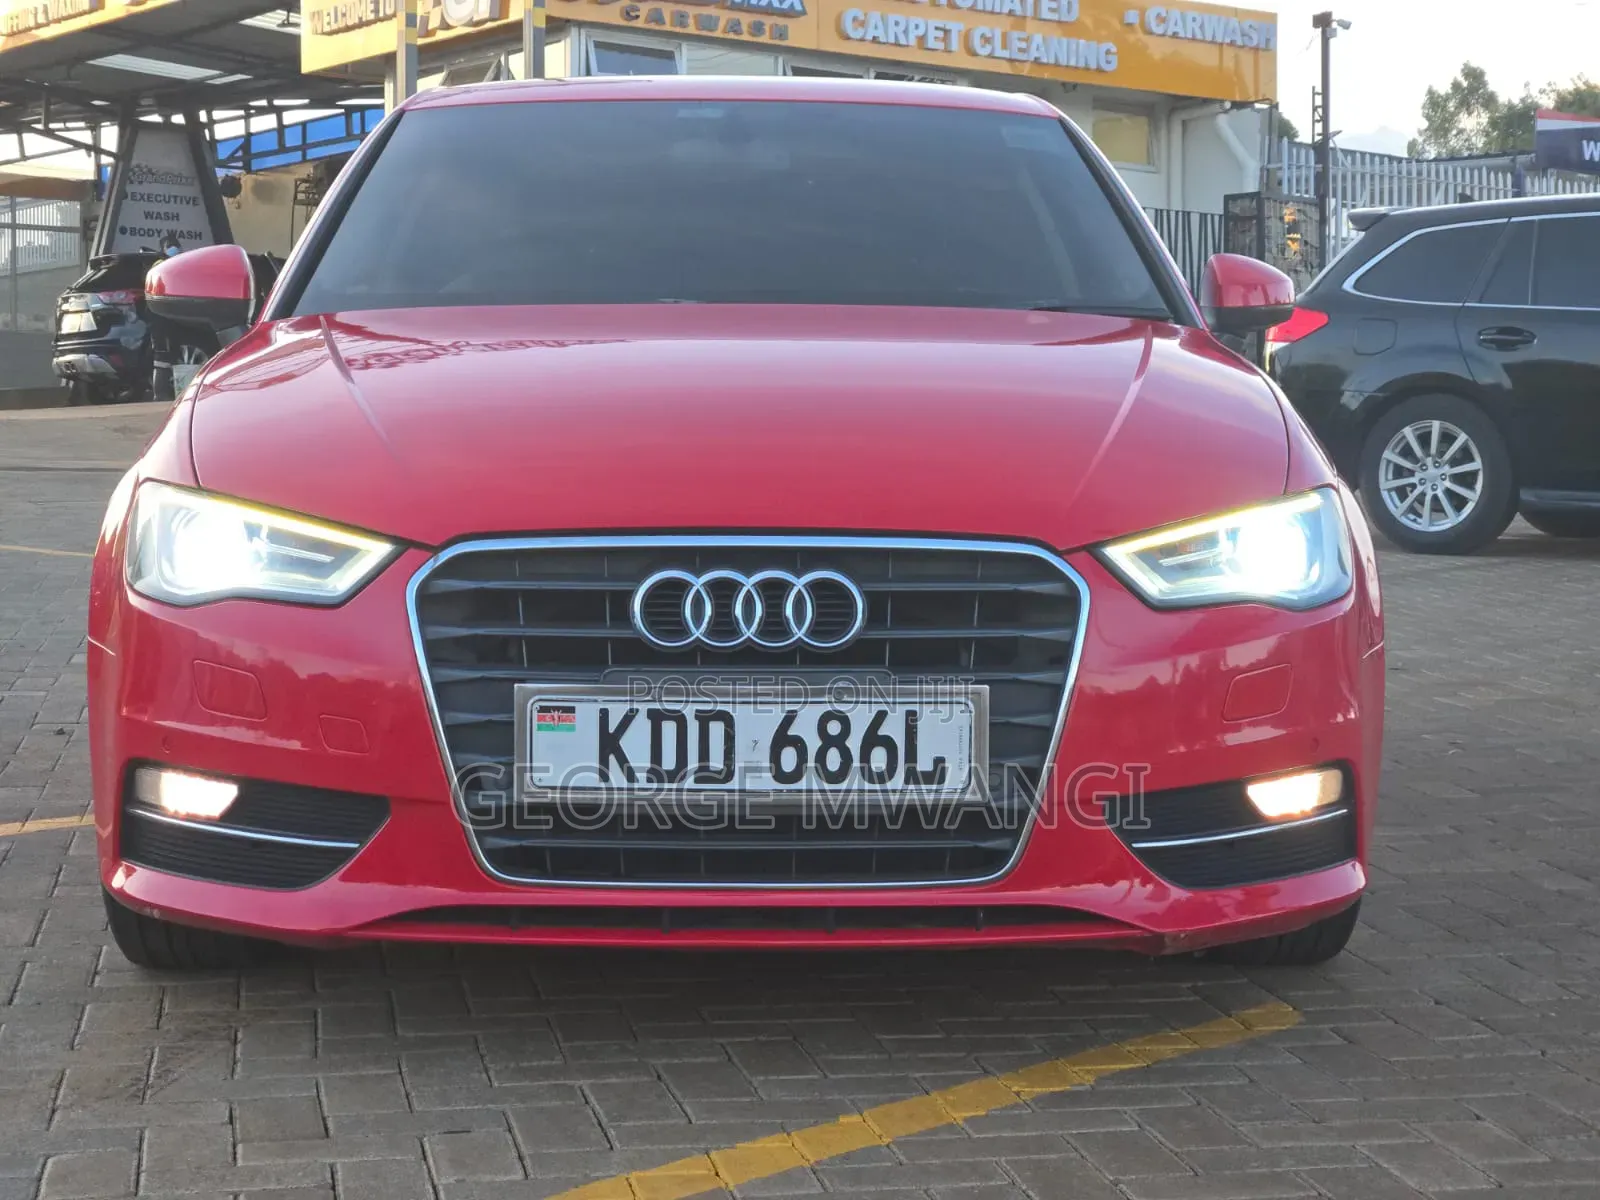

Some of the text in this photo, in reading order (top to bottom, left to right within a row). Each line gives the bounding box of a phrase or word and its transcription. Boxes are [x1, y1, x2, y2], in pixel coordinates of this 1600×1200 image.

[620, 4, 788, 40] CARWASH
[842, 7, 1118, 72] CARPET CLEANING
[1145, 6, 1276, 50] CARWASH
[130, 191, 200, 207] EXECUTIVE
[143, 210, 180, 222] WASH
[129, 226, 203, 241] BODY WASH
[599, 707, 736, 785] KDD
[769, 708, 946, 786] 686L
